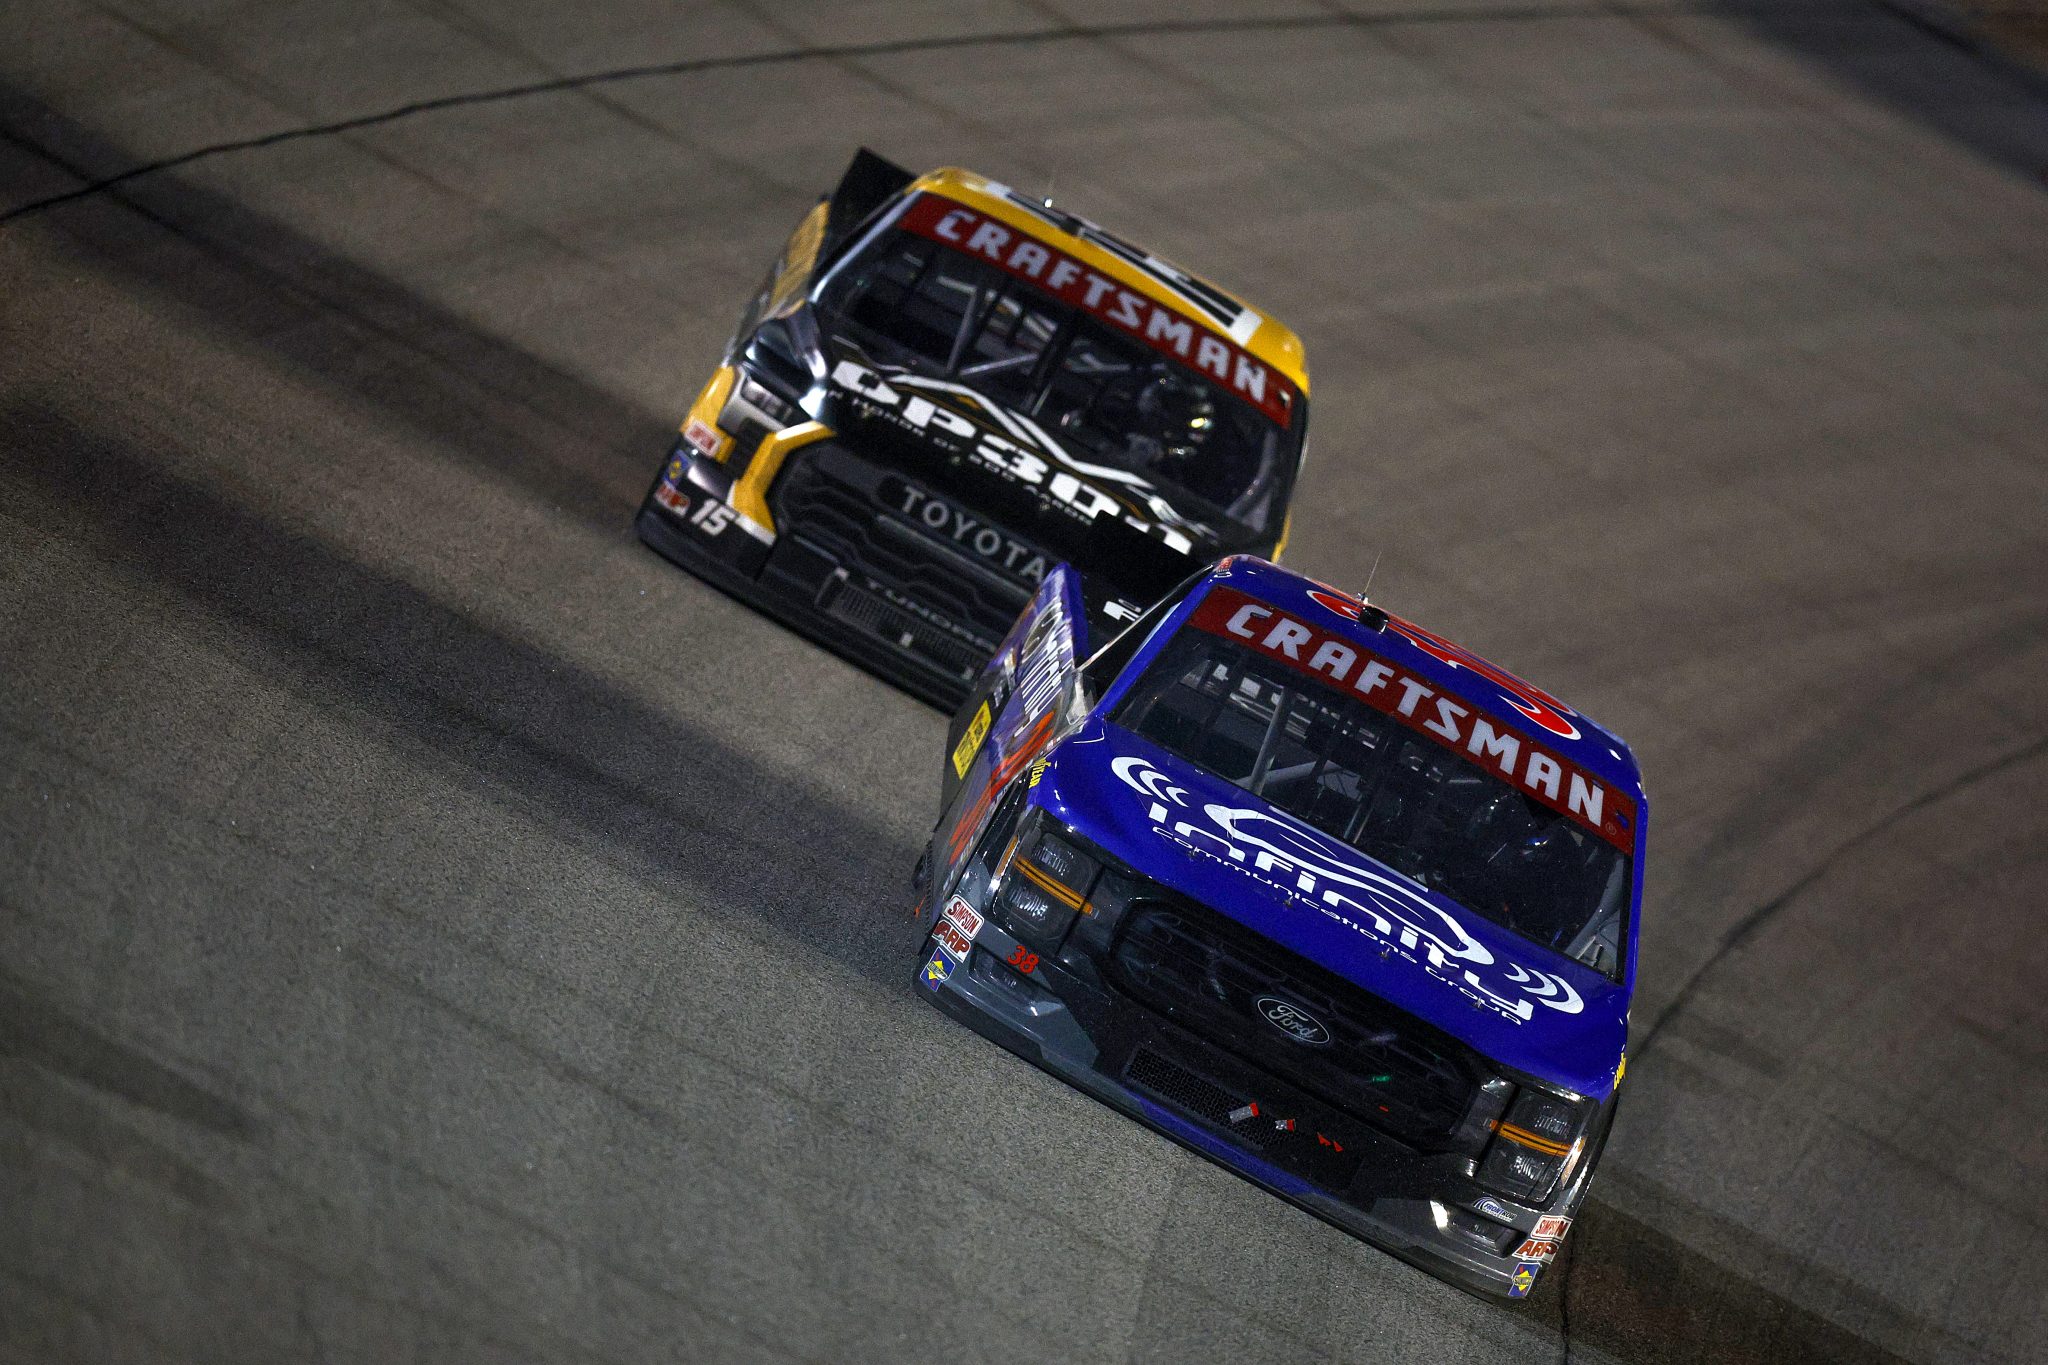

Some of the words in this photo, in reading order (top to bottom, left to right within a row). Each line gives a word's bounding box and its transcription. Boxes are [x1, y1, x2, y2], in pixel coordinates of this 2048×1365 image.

[934, 208, 1266, 401] CRAFTSMAN
[689, 497, 737, 536] 15
[901, 485, 1047, 582] TOYOTA
[1226, 604, 1605, 827] CRAFTSMAN
[947, 900, 980, 936] SIMPSON
[933, 920, 971, 955] ARP
[1007, 945, 1040, 974] 38
[1268, 1005, 1318, 1038] Ford
[1516, 1240, 1558, 1257] ARP
